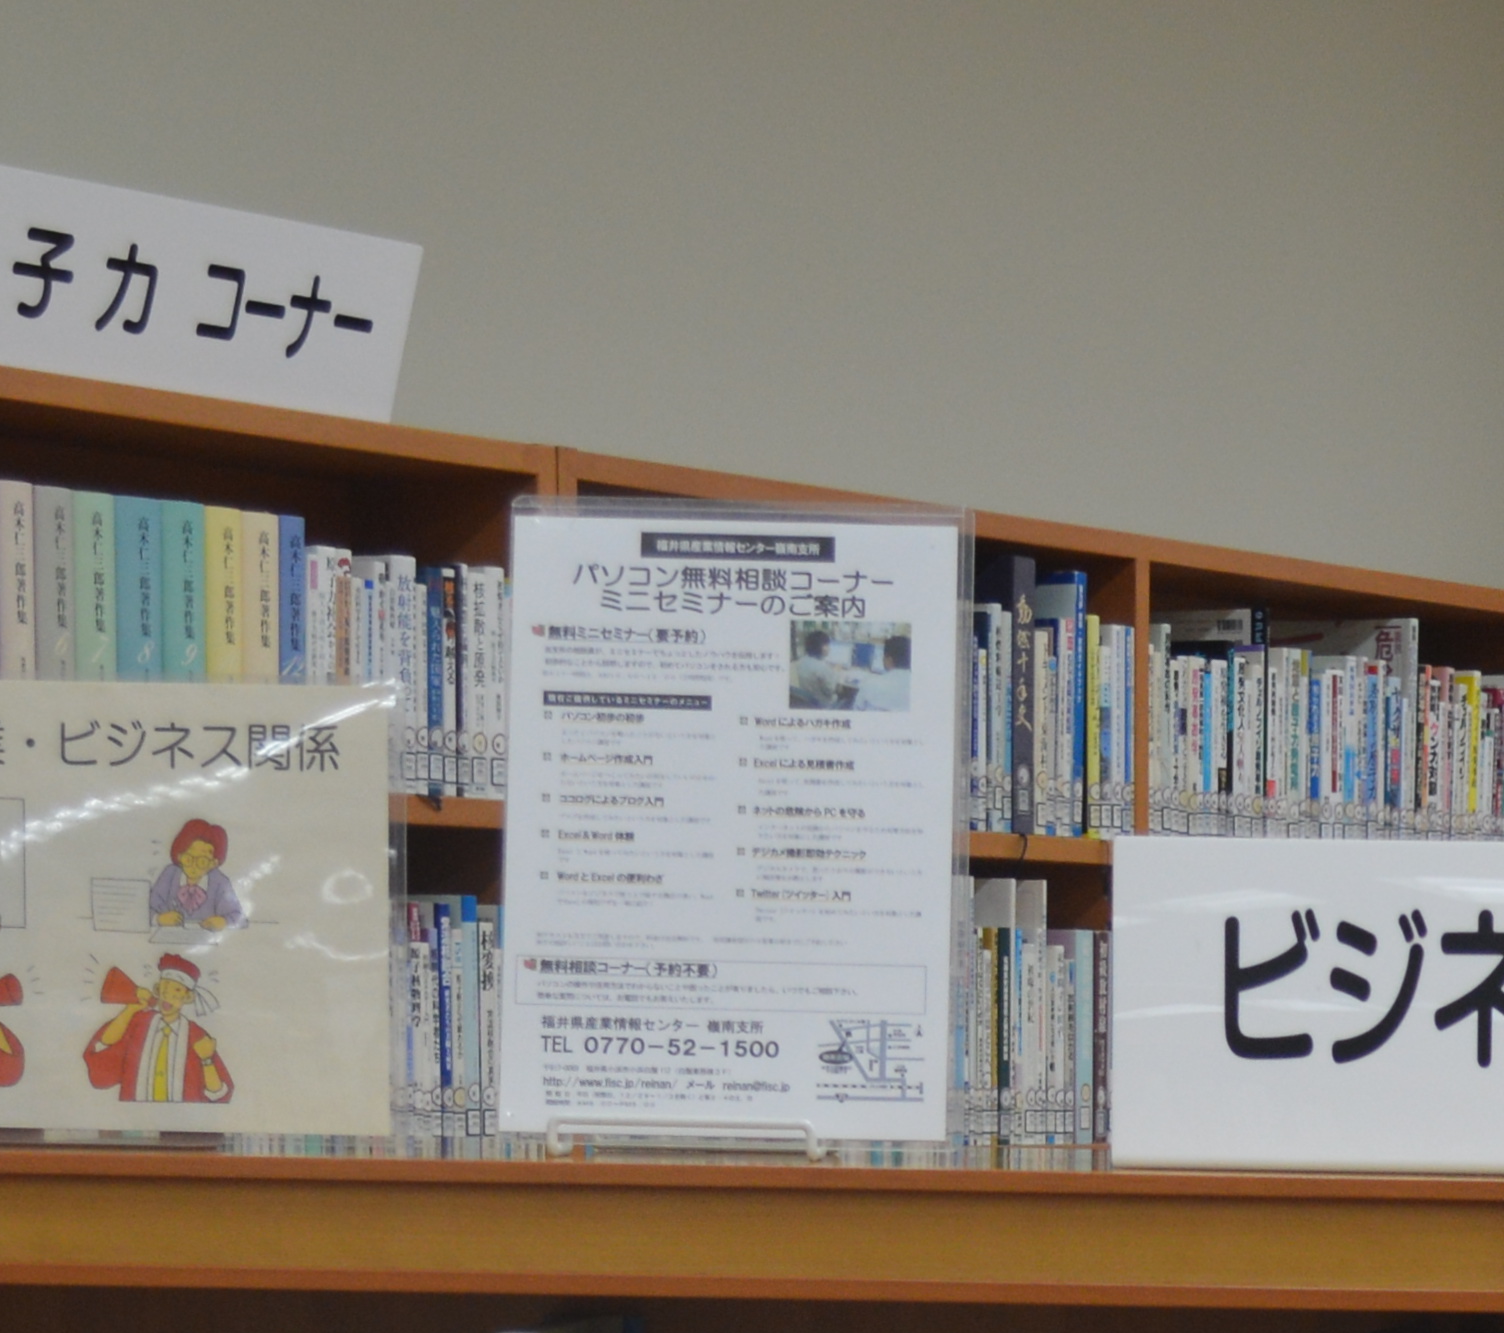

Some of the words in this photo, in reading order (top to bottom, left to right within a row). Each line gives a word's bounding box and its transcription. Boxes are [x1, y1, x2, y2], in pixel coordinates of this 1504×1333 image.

[195, 262, 374, 358] コーナー
[573, 564, 894, 594] パソコン無料相談コーナー
[600, 590, 866, 618] ミニセミナーのご案内
[560, 753, 653, 765] ホームページ作成入門
[541, 1016, 700, 1033] 福井県産業情報センター
[707, 1019, 763, 1034] 嶺南支所
[541, 1036, 573, 1054] TEL
[584, 1036, 779, 1058] 0770-52-1500
[686, 1079, 714, 1091] メール
